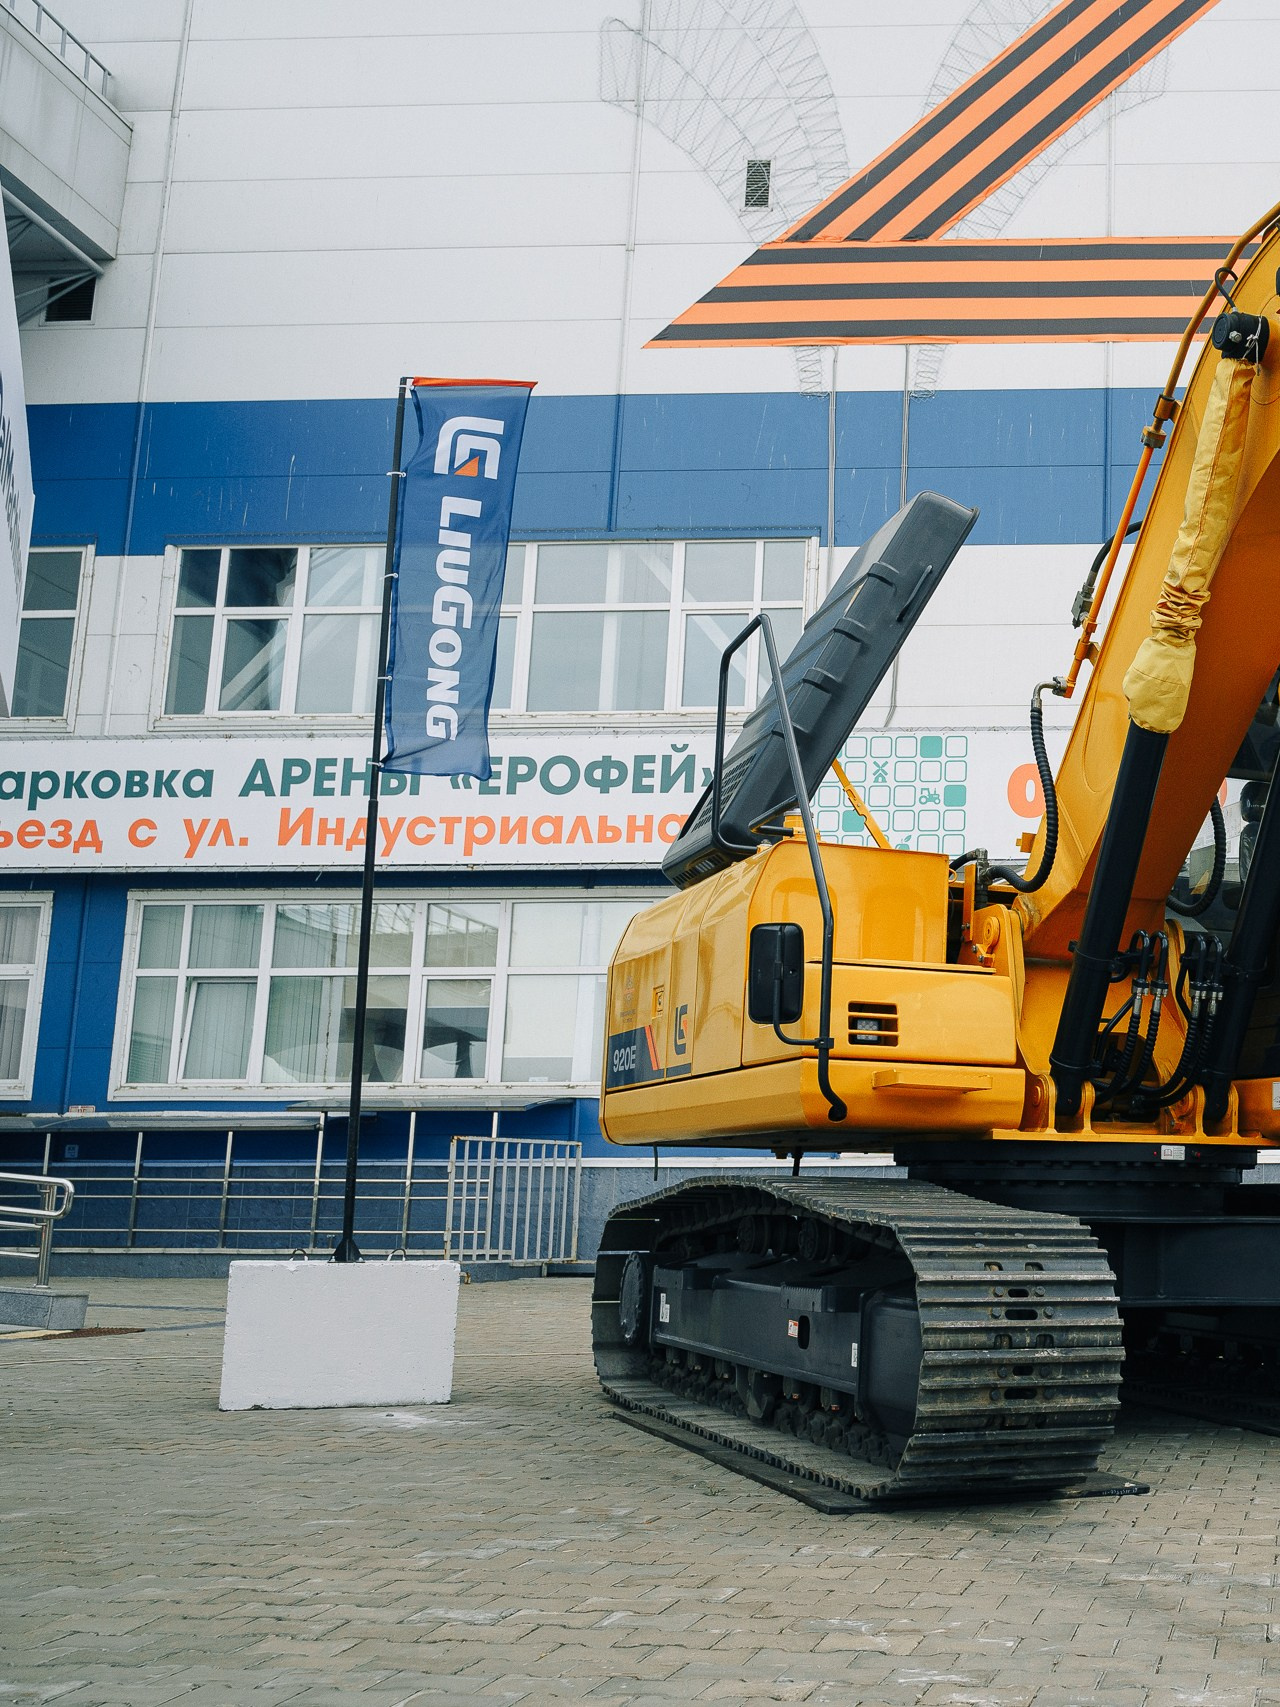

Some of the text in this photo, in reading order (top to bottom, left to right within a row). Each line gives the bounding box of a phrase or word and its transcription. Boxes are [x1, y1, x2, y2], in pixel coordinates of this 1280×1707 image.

[426, 496, 483, 741] LIUGONG
[239, 757, 421, 797] АРЕНЫ
[128, 818, 158, 848] с
[183, 818, 249, 859] ул.
[613, 1045, 637, 1074] 920E
